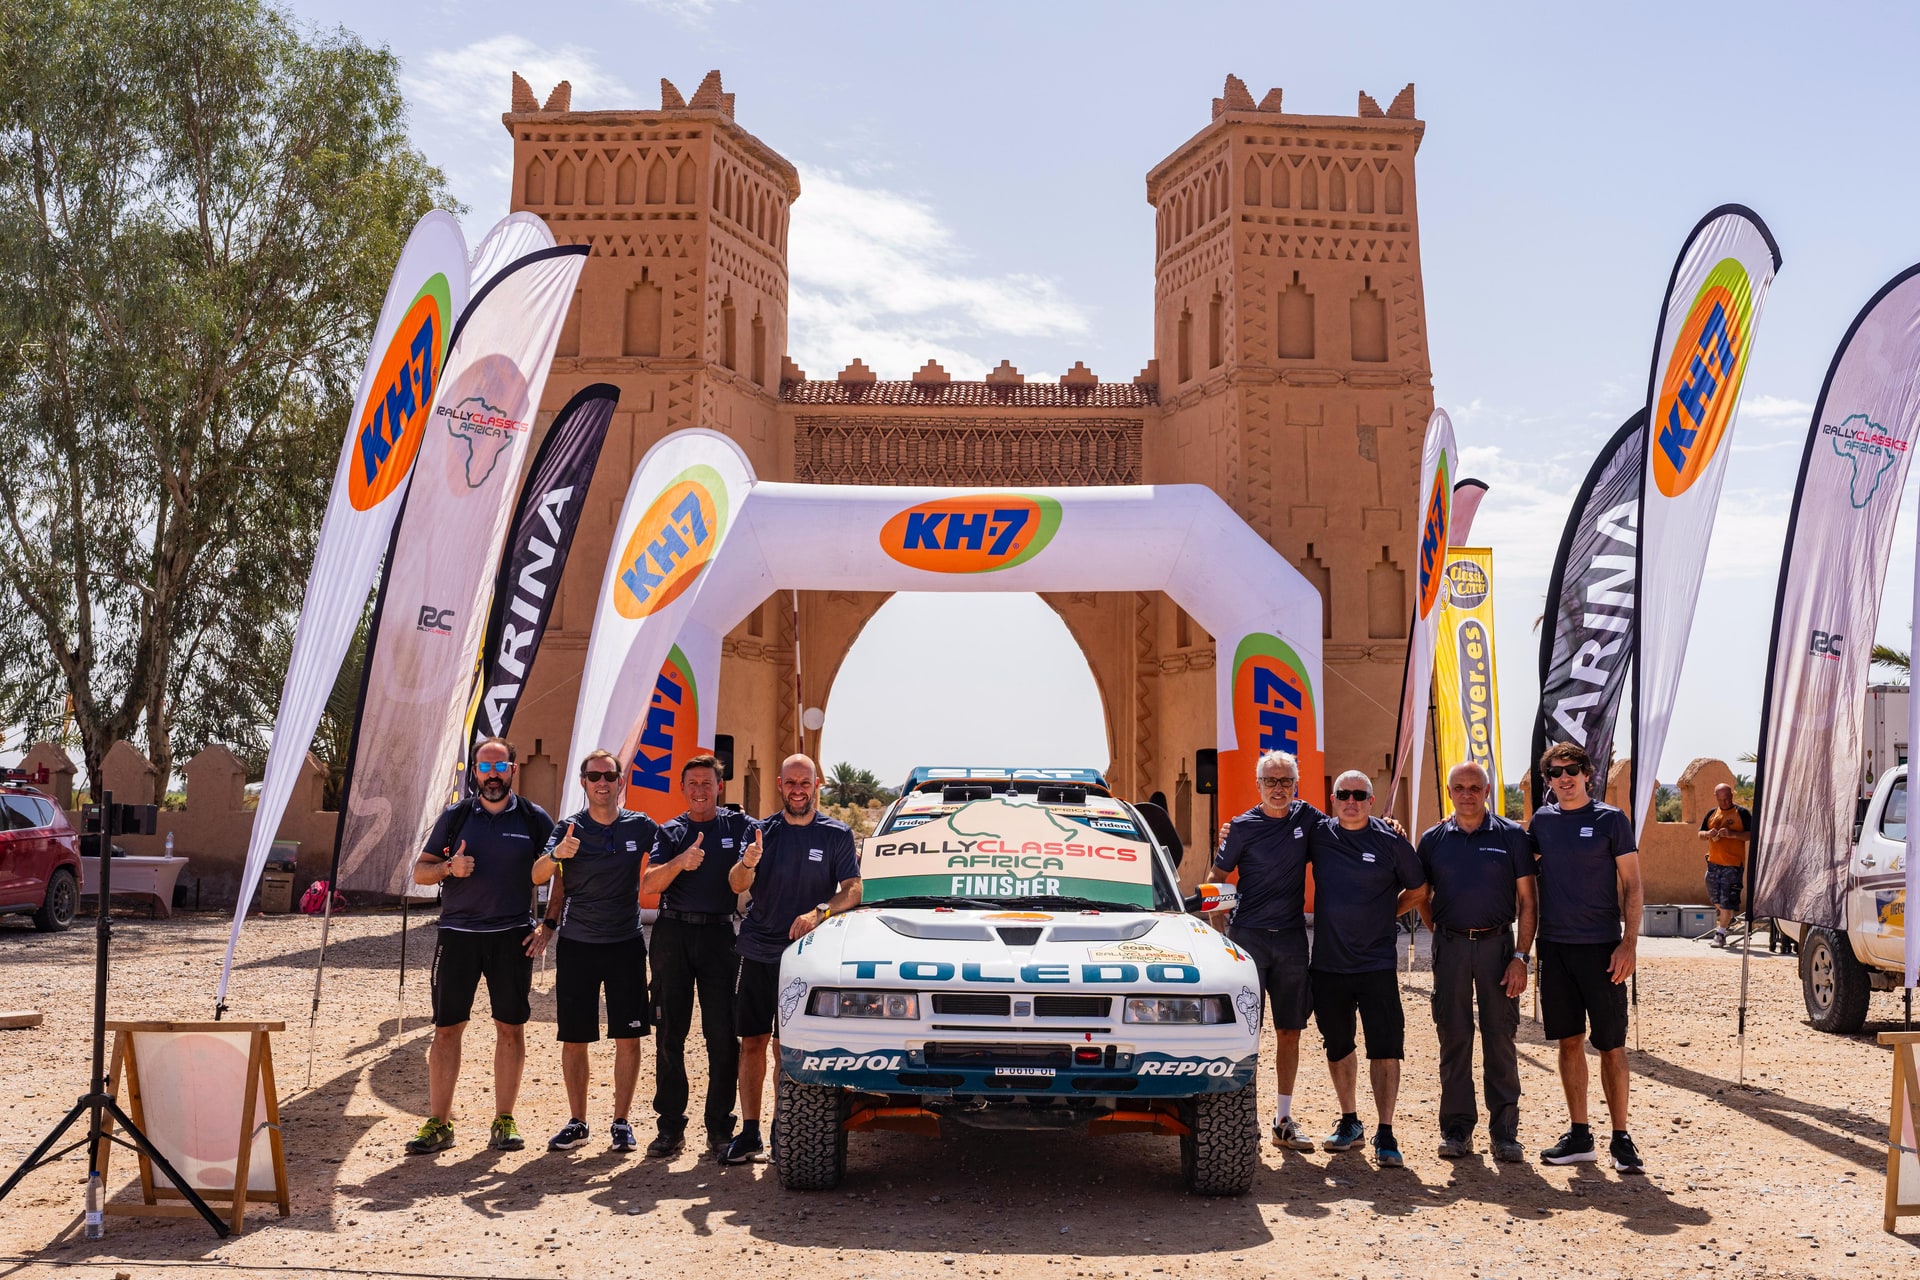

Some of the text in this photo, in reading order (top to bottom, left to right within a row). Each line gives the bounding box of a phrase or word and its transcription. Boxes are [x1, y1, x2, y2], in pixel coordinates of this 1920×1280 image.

[459, 422, 501, 438] AFRICA
[1823, 424, 1909, 451] RALLYCLASSICS
[1844, 440, 1882, 456] AFRICA
[475, 485, 574, 742] ARINA
[1551, 498, 1638, 748] ARINA
[927, 768, 1084, 779] SEAT
[1093, 821, 1132, 830] Trident
[875, 840, 1138, 862] RALLYCLASSICS
[947, 855, 1064, 871] AFRICA
[951, 876, 1061, 897] FINISHER
[1204, 894, 1236, 903] REPSOL
[842, 961, 1200, 983] TOLEDO
[1136, 1061, 1237, 1078] REPSOL
